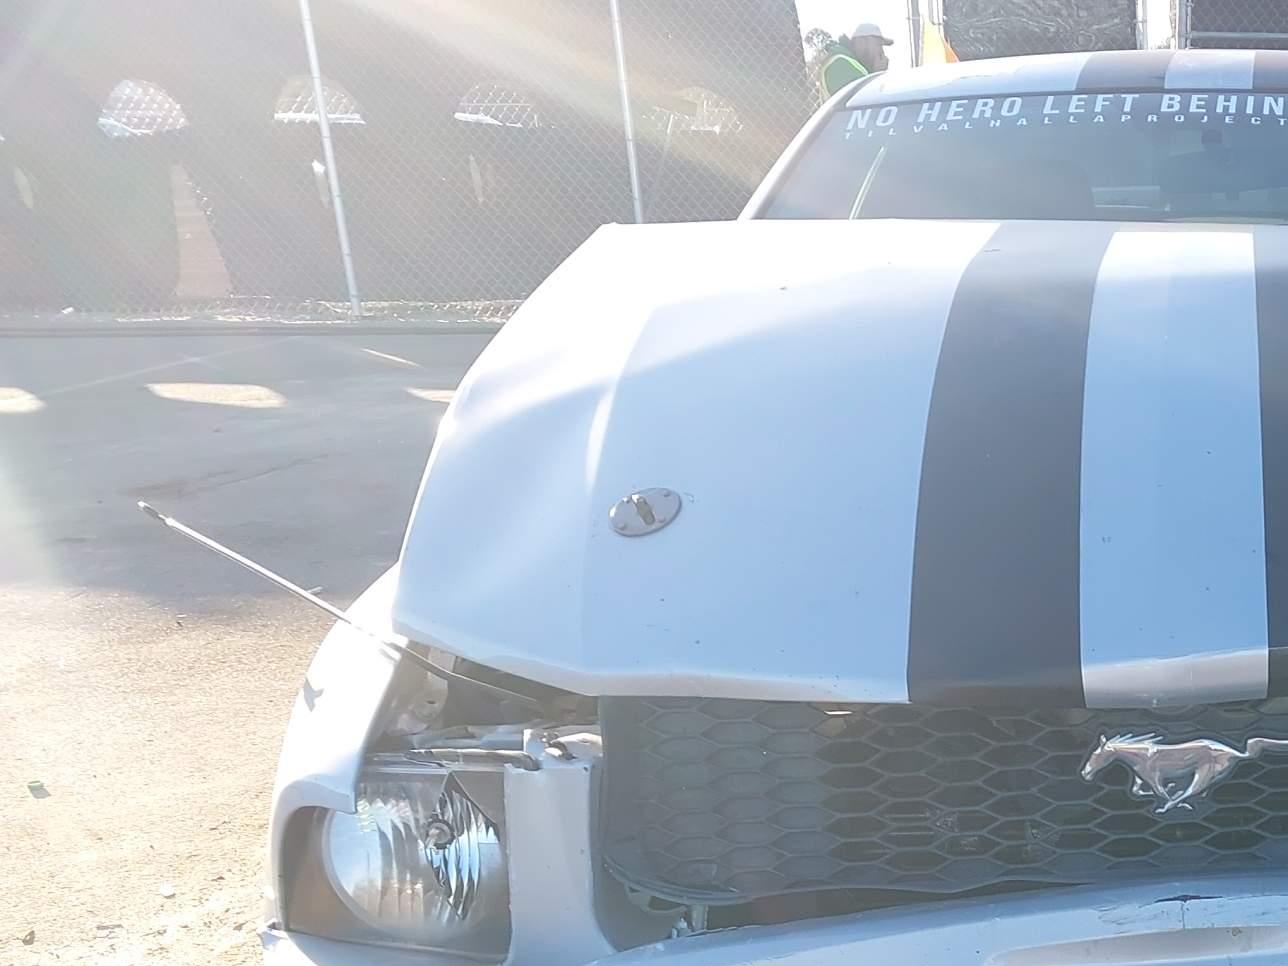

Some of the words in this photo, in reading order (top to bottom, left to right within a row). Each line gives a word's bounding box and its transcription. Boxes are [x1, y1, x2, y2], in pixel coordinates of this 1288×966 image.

[846, 106, 899, 130] NO
[917, 97, 1023, 123] HERO
[1042, 94, 1139, 114] LEFT
